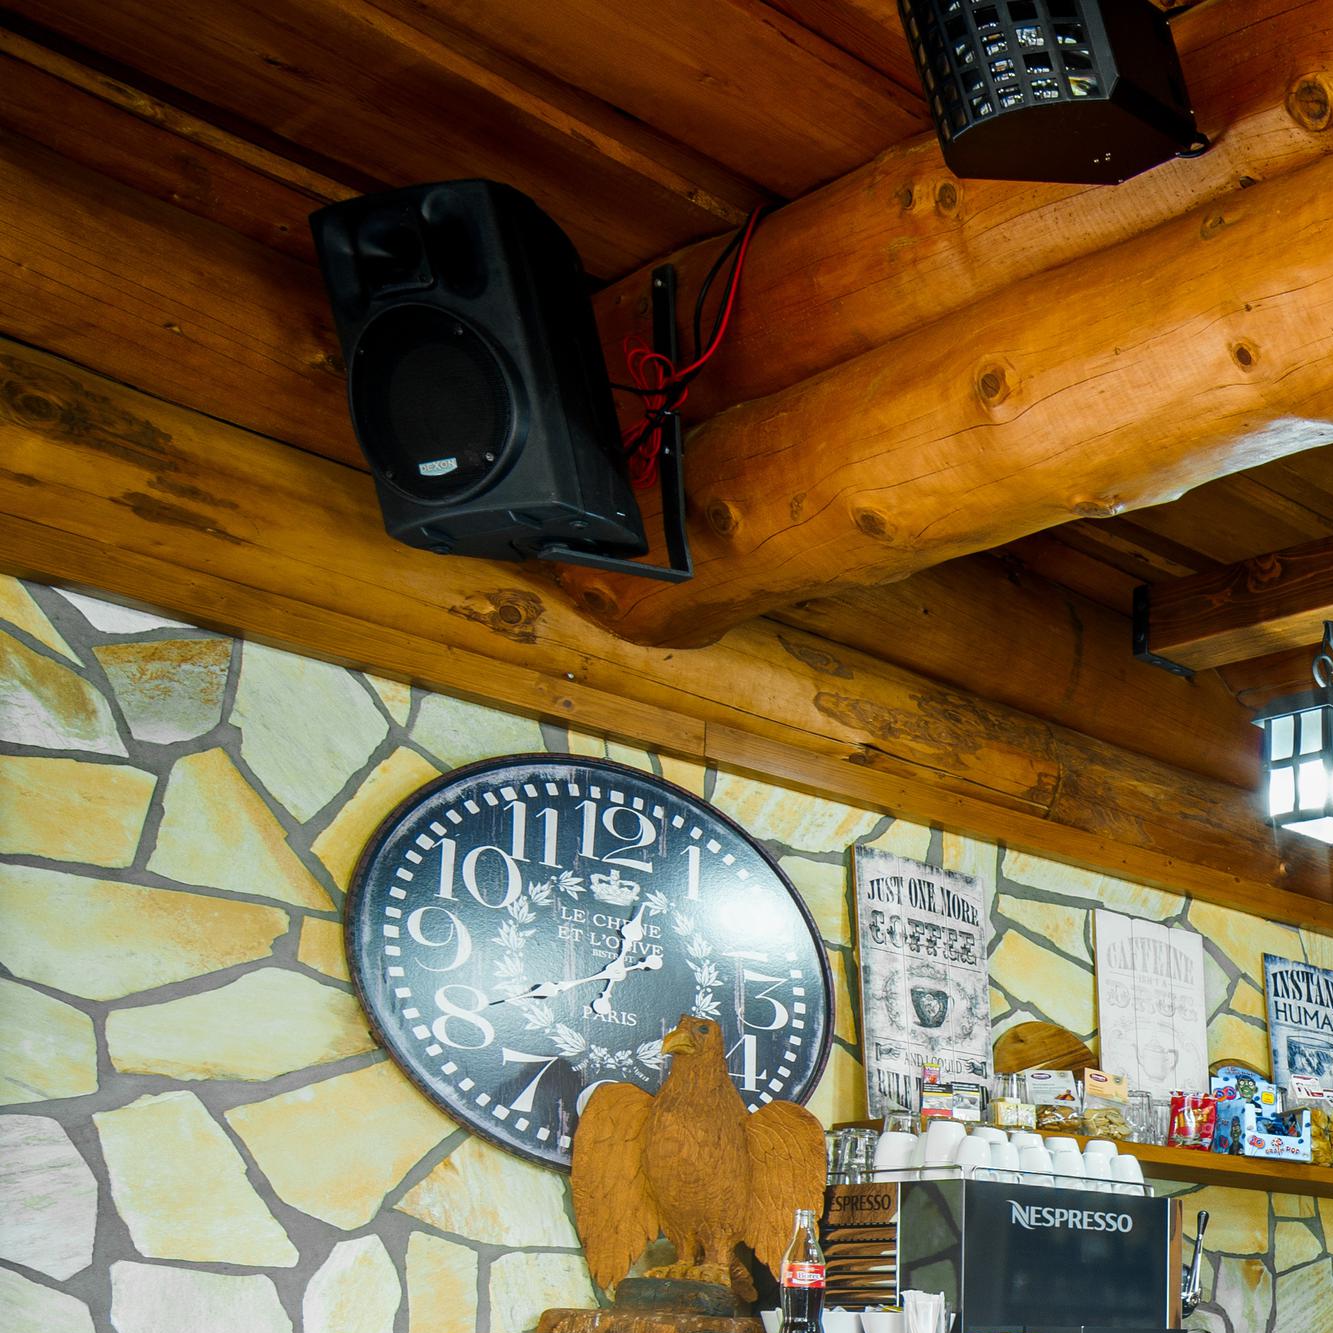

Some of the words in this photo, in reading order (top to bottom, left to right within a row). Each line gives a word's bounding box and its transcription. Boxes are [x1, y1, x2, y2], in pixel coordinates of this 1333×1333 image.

[503, 799, 563, 869] 11
[575, 799, 657, 873] 12
[429, 838, 523, 909] 10
[680, 844, 701, 900] 1
[561, 906, 586, 923] LE
[592, 913, 662, 939] CHNE
[867, 876, 903, 906] JUST
[908, 877, 937, 913] ONE
[941, 886, 979, 927] MORE
[407, 906, 472, 972] 9
[558, 925, 583, 942] ET
[590, 932, 664, 958] L'OIVE
[592, 949, 635, 964] BISTRT
[869, 909, 977, 967] COFFEE
[1106, 937, 1195, 985] CAFFEINE
[431, 984, 495, 1049] 8
[736, 969, 790, 1031] 3
[502, 1047, 559, 1112] 7
[724, 1033, 767, 1092] 4
[904, 1051, 924, 1068] AND
[931, 1057, 963, 1074] COULD
[830, 1193, 892, 1212] ESPRESSO
[1006, 1199, 1134, 1233] NESPRESSO
